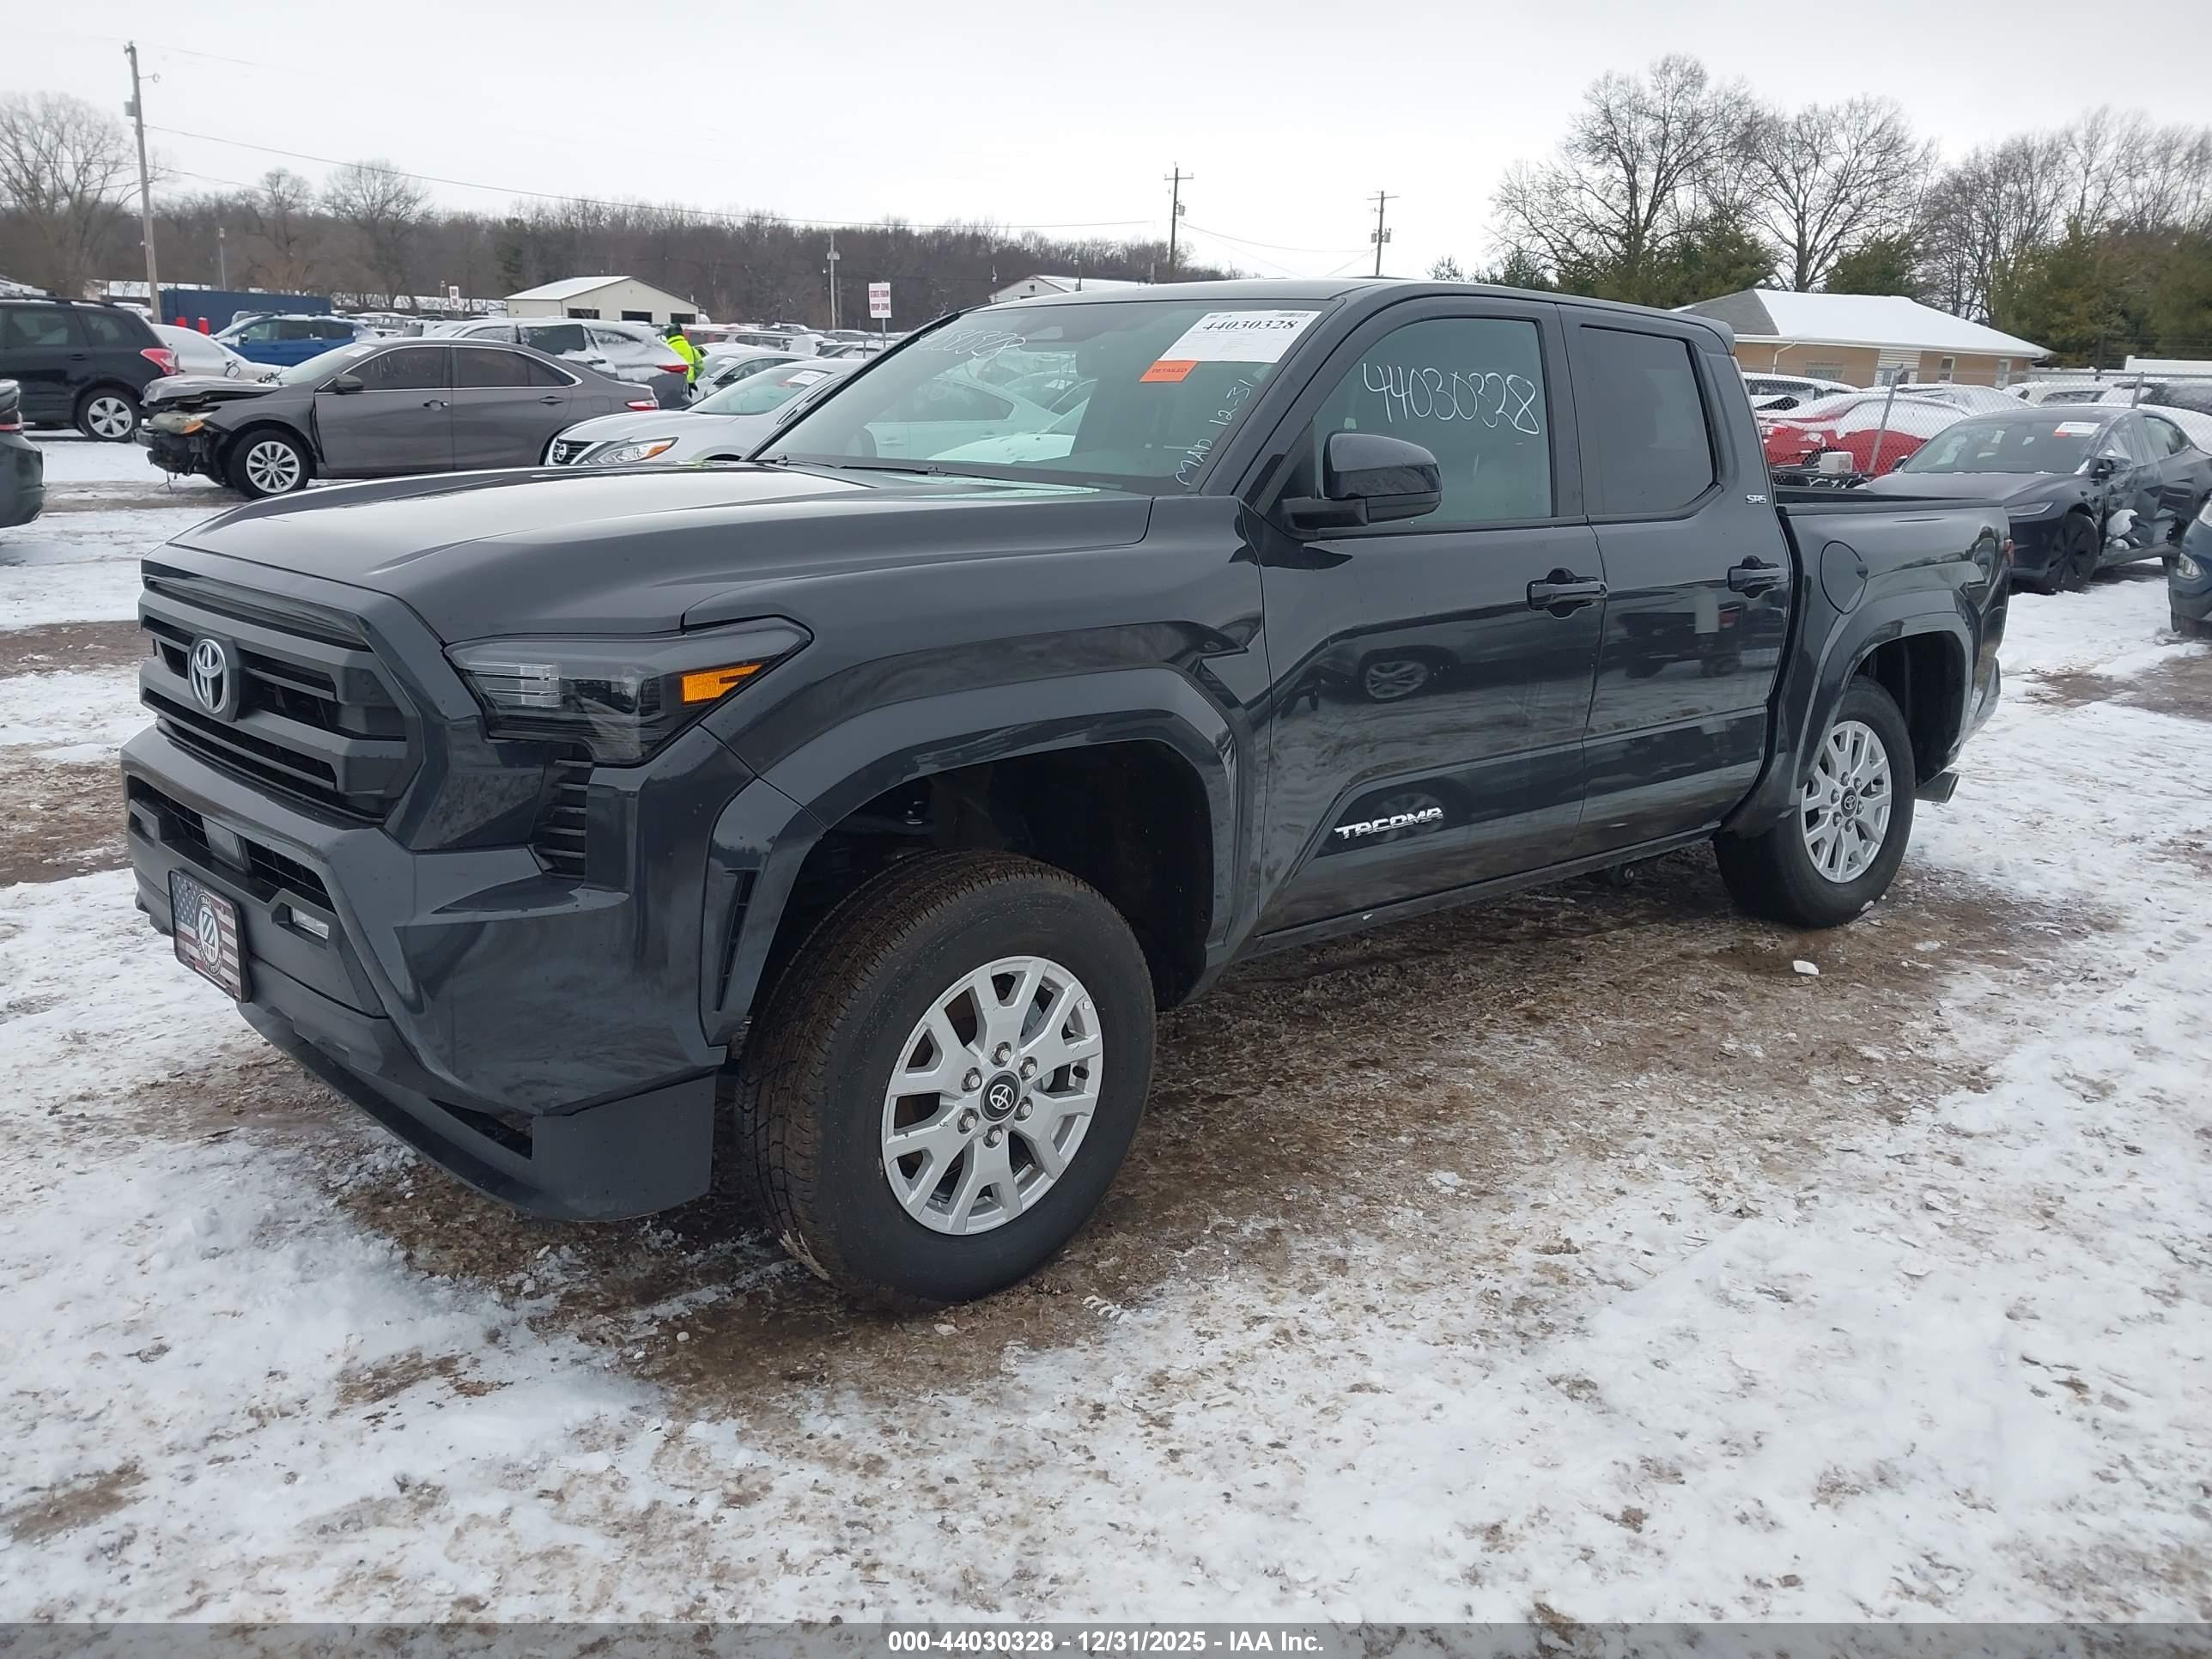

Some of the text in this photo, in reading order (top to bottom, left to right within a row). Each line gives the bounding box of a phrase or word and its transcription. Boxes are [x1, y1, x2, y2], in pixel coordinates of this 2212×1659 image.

[1202, 320, 1299, 331] 44030328
[1208, 379, 1256, 426] 12-31
[1362, 362, 1540, 435] 44030328
[1746, 494, 1767, 504] SR5
[1334, 807, 1443, 840] TACOMA
